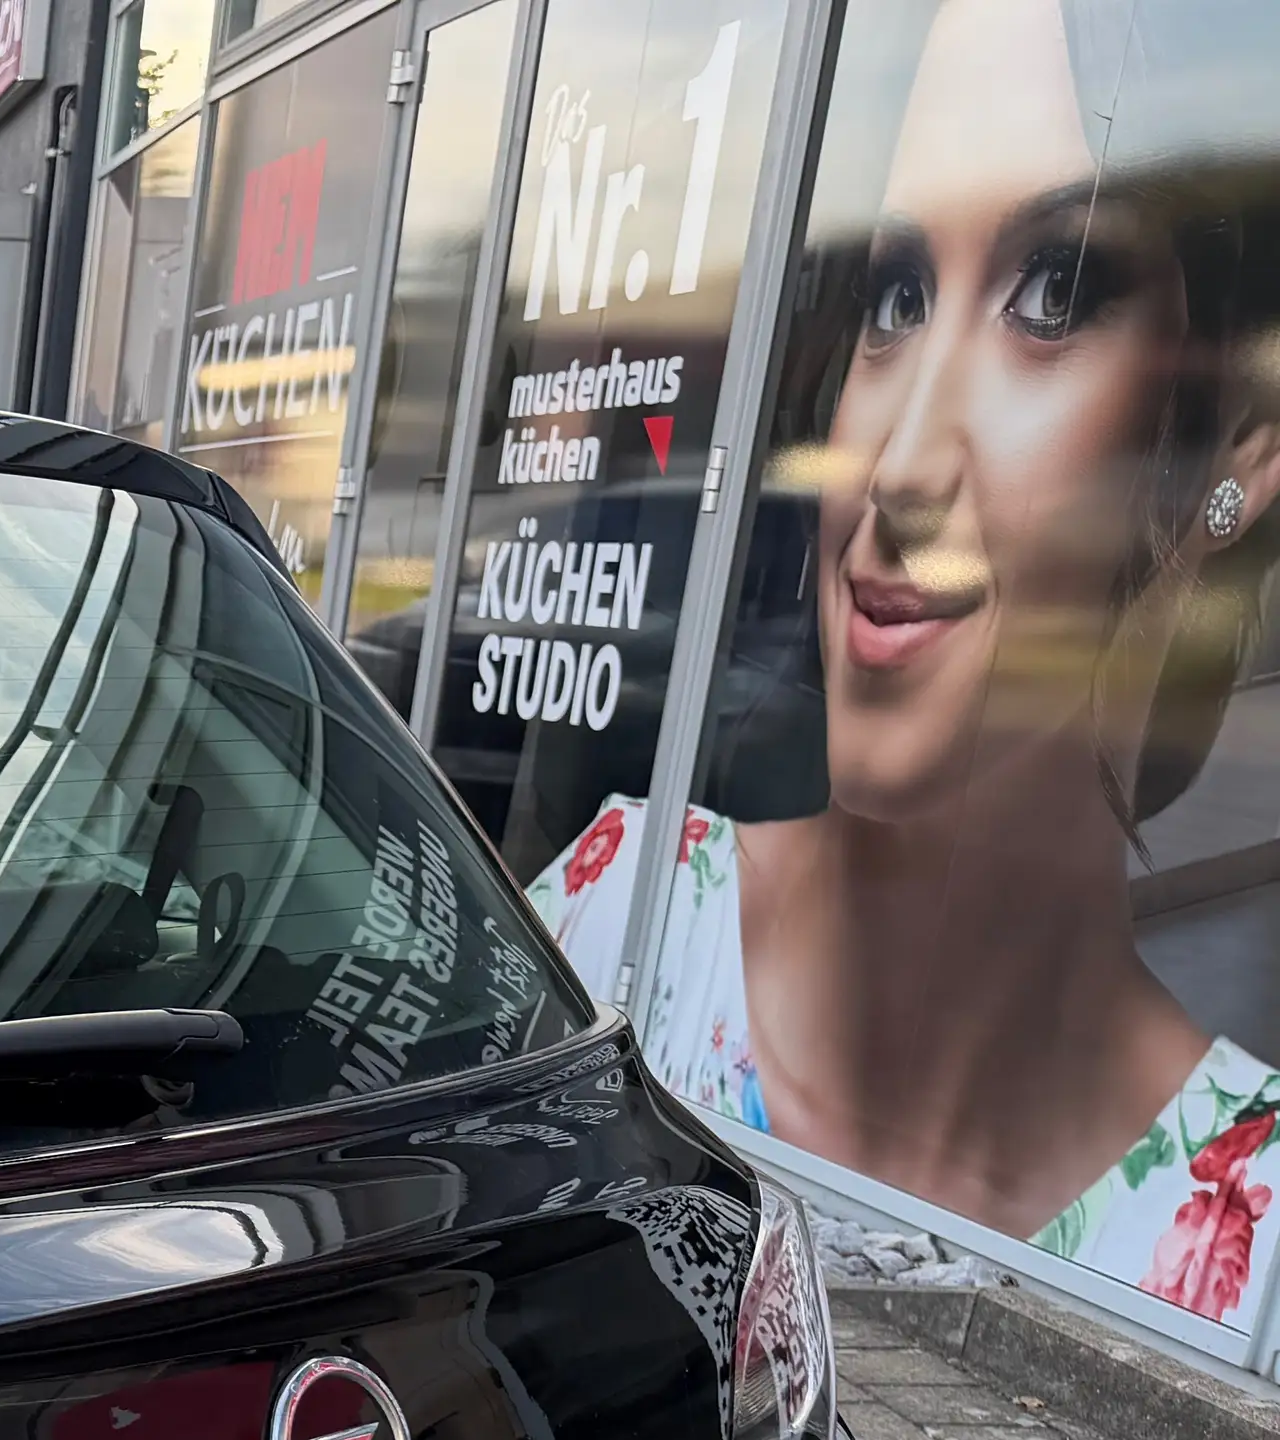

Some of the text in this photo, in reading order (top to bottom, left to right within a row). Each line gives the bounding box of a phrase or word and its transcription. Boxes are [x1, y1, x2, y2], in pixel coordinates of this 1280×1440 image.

[523, 20, 740, 321] Nr. 1
[180, 293, 354, 434] KÜCHEN
[508, 347, 684, 418] musterhaus
[498, 424, 601, 484] küchen
[477, 517, 654, 630] KÜCHEN
[472, 633, 622, 731] STUDIO
